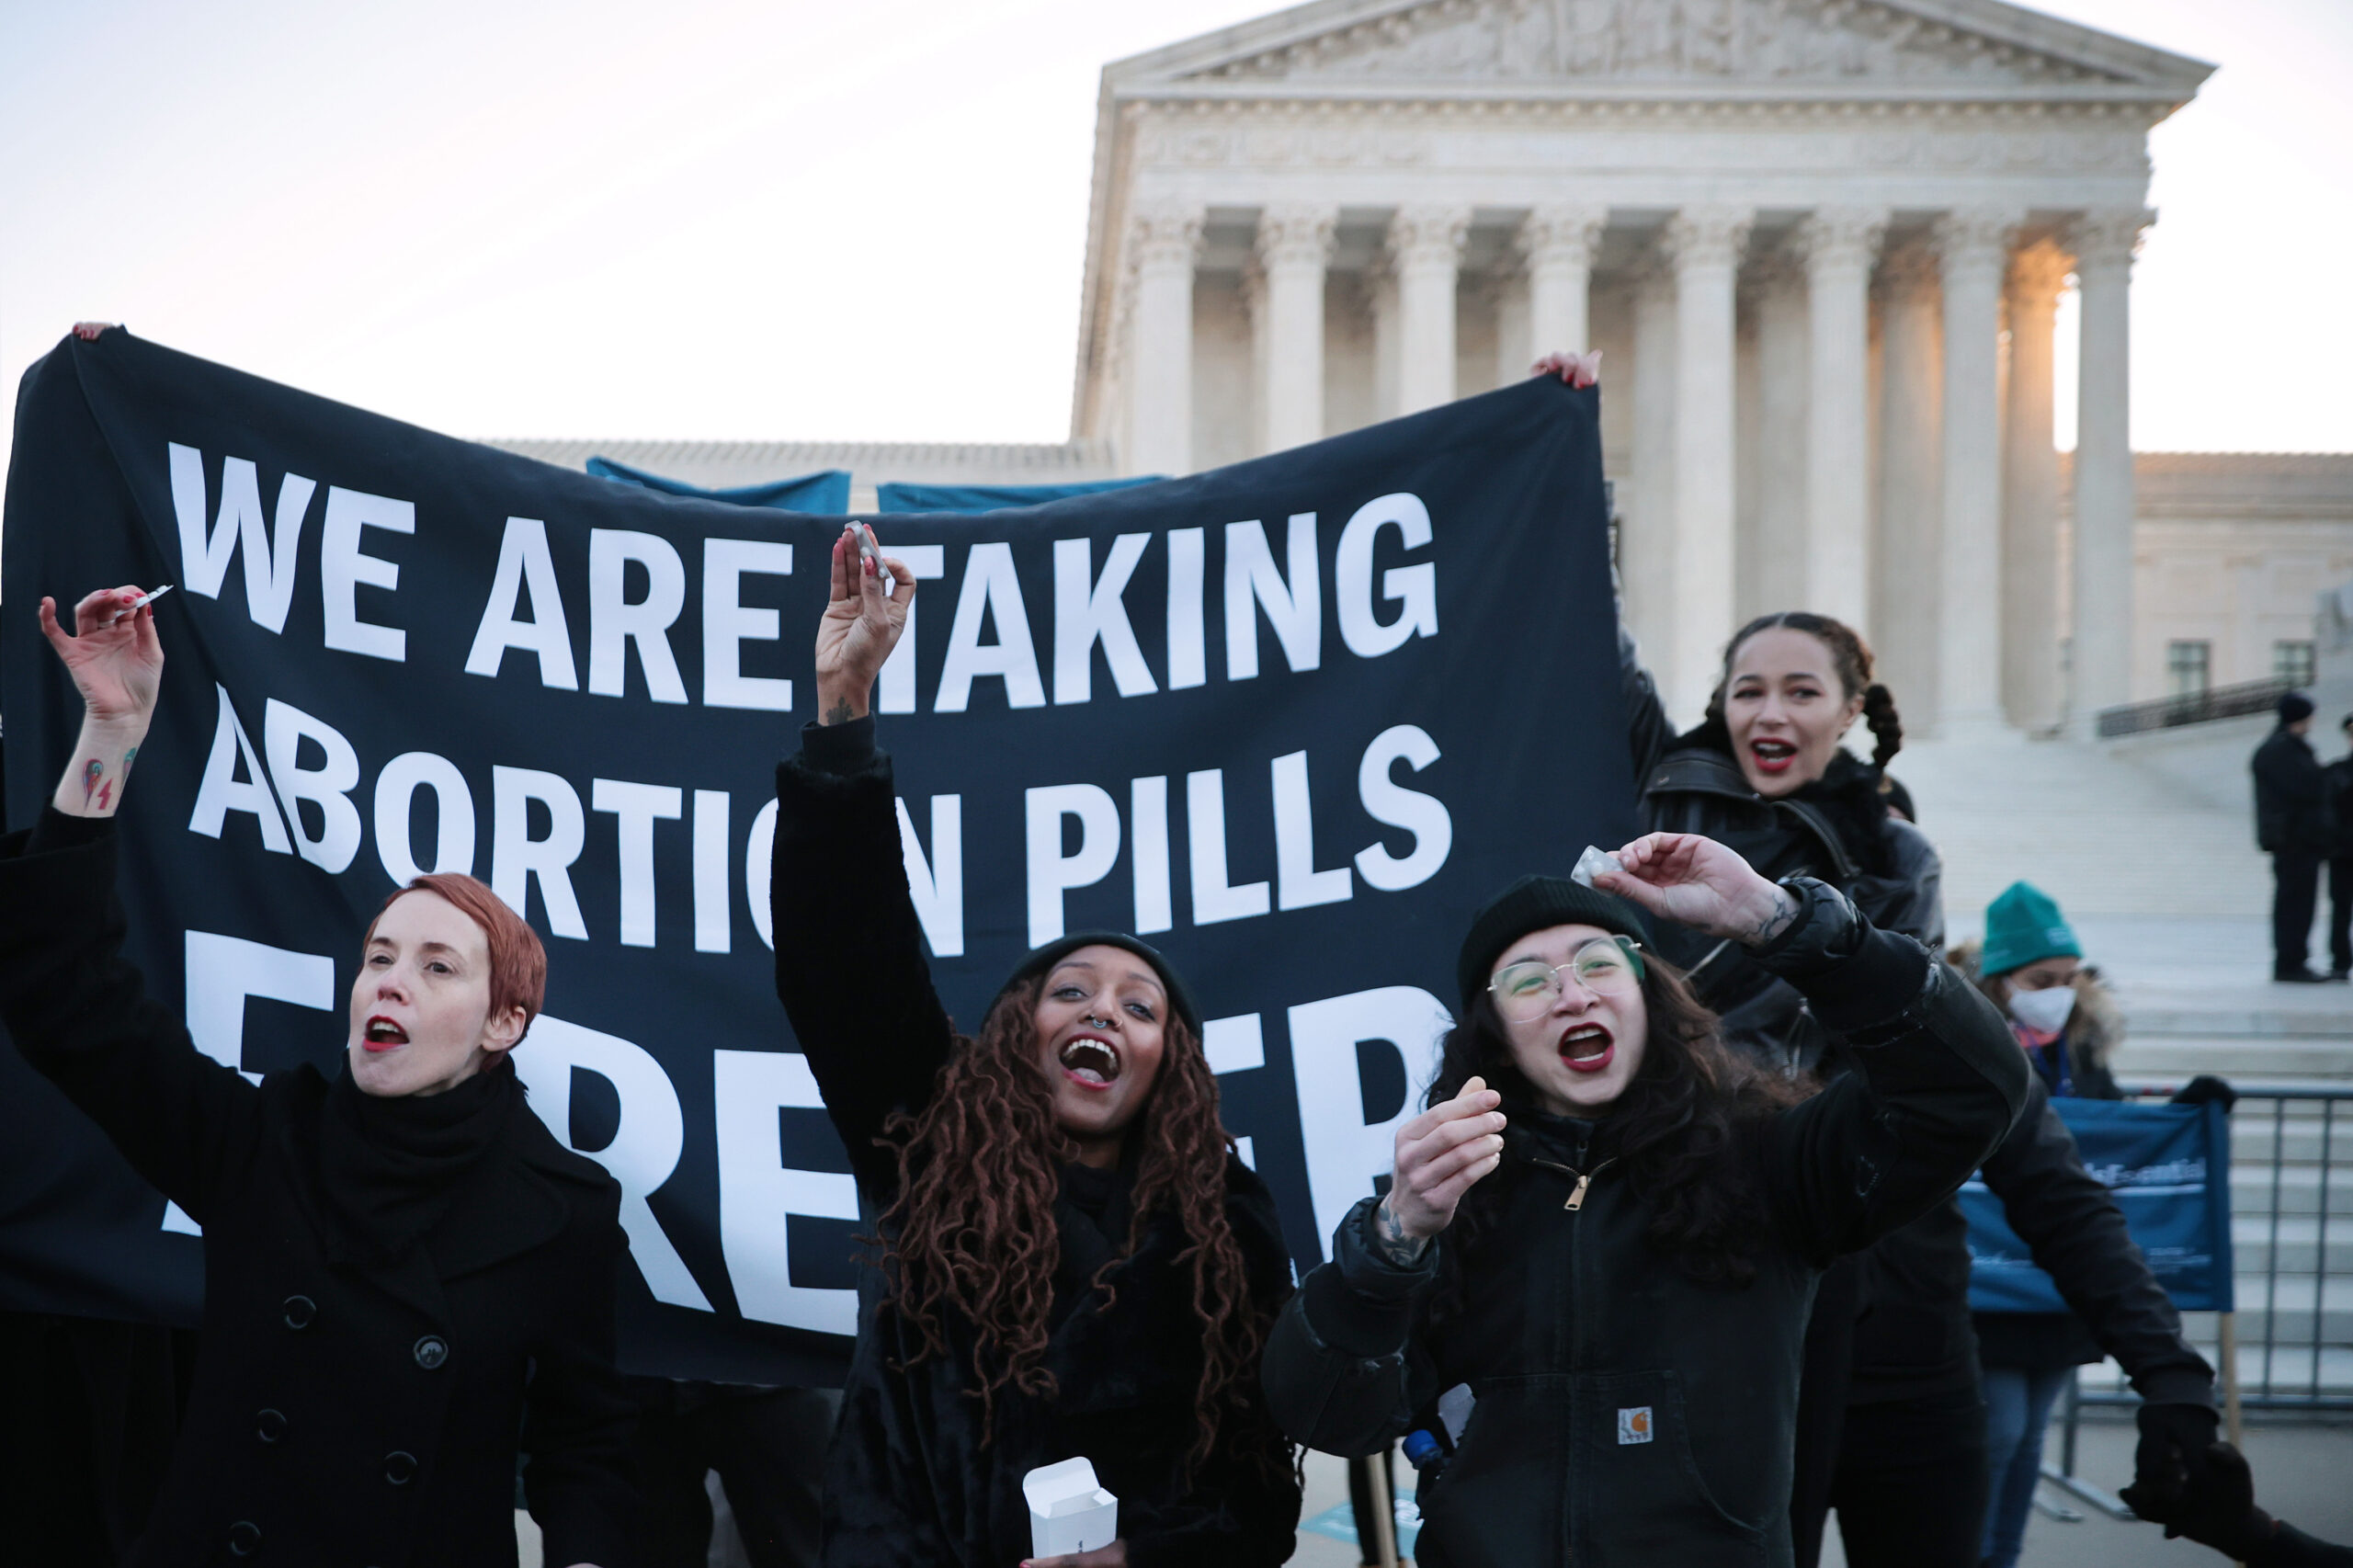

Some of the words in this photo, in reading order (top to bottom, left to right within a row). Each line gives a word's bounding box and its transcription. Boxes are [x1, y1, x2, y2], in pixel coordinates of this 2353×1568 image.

[169, 442, 415, 662] WE
[465, 517, 792, 712] ARE
[869, 493, 1438, 713] TAKING
[1025, 724, 1452, 949] PILLS
